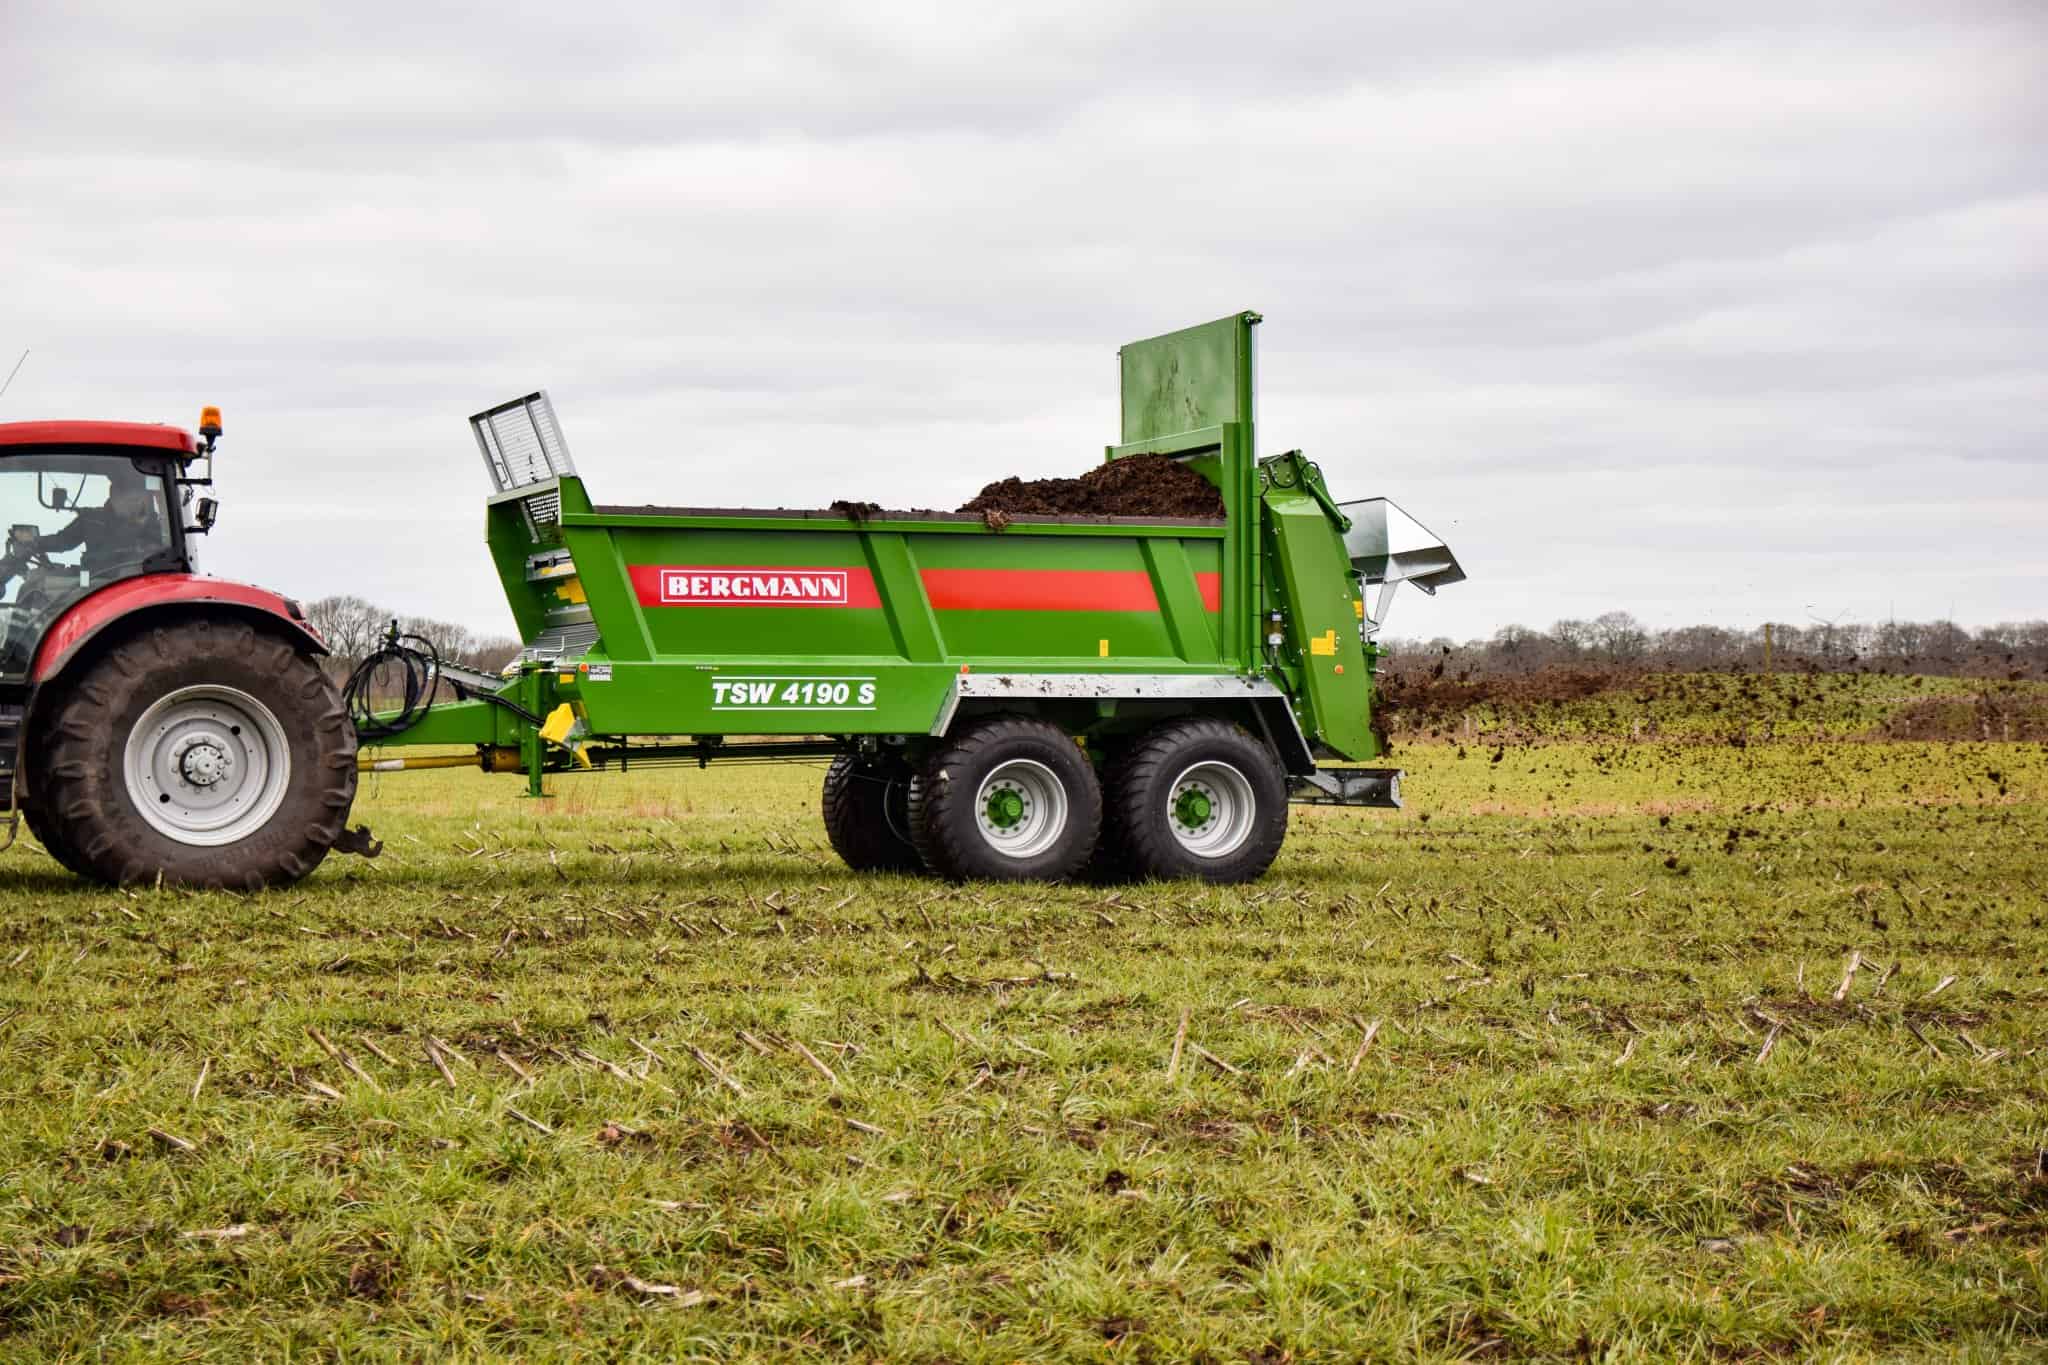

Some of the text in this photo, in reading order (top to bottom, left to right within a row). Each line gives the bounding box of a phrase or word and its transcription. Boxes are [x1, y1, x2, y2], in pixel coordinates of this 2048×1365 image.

[668, 576, 841, 597] BERGMANN
[712, 682, 875, 704] TSW 4190 S
